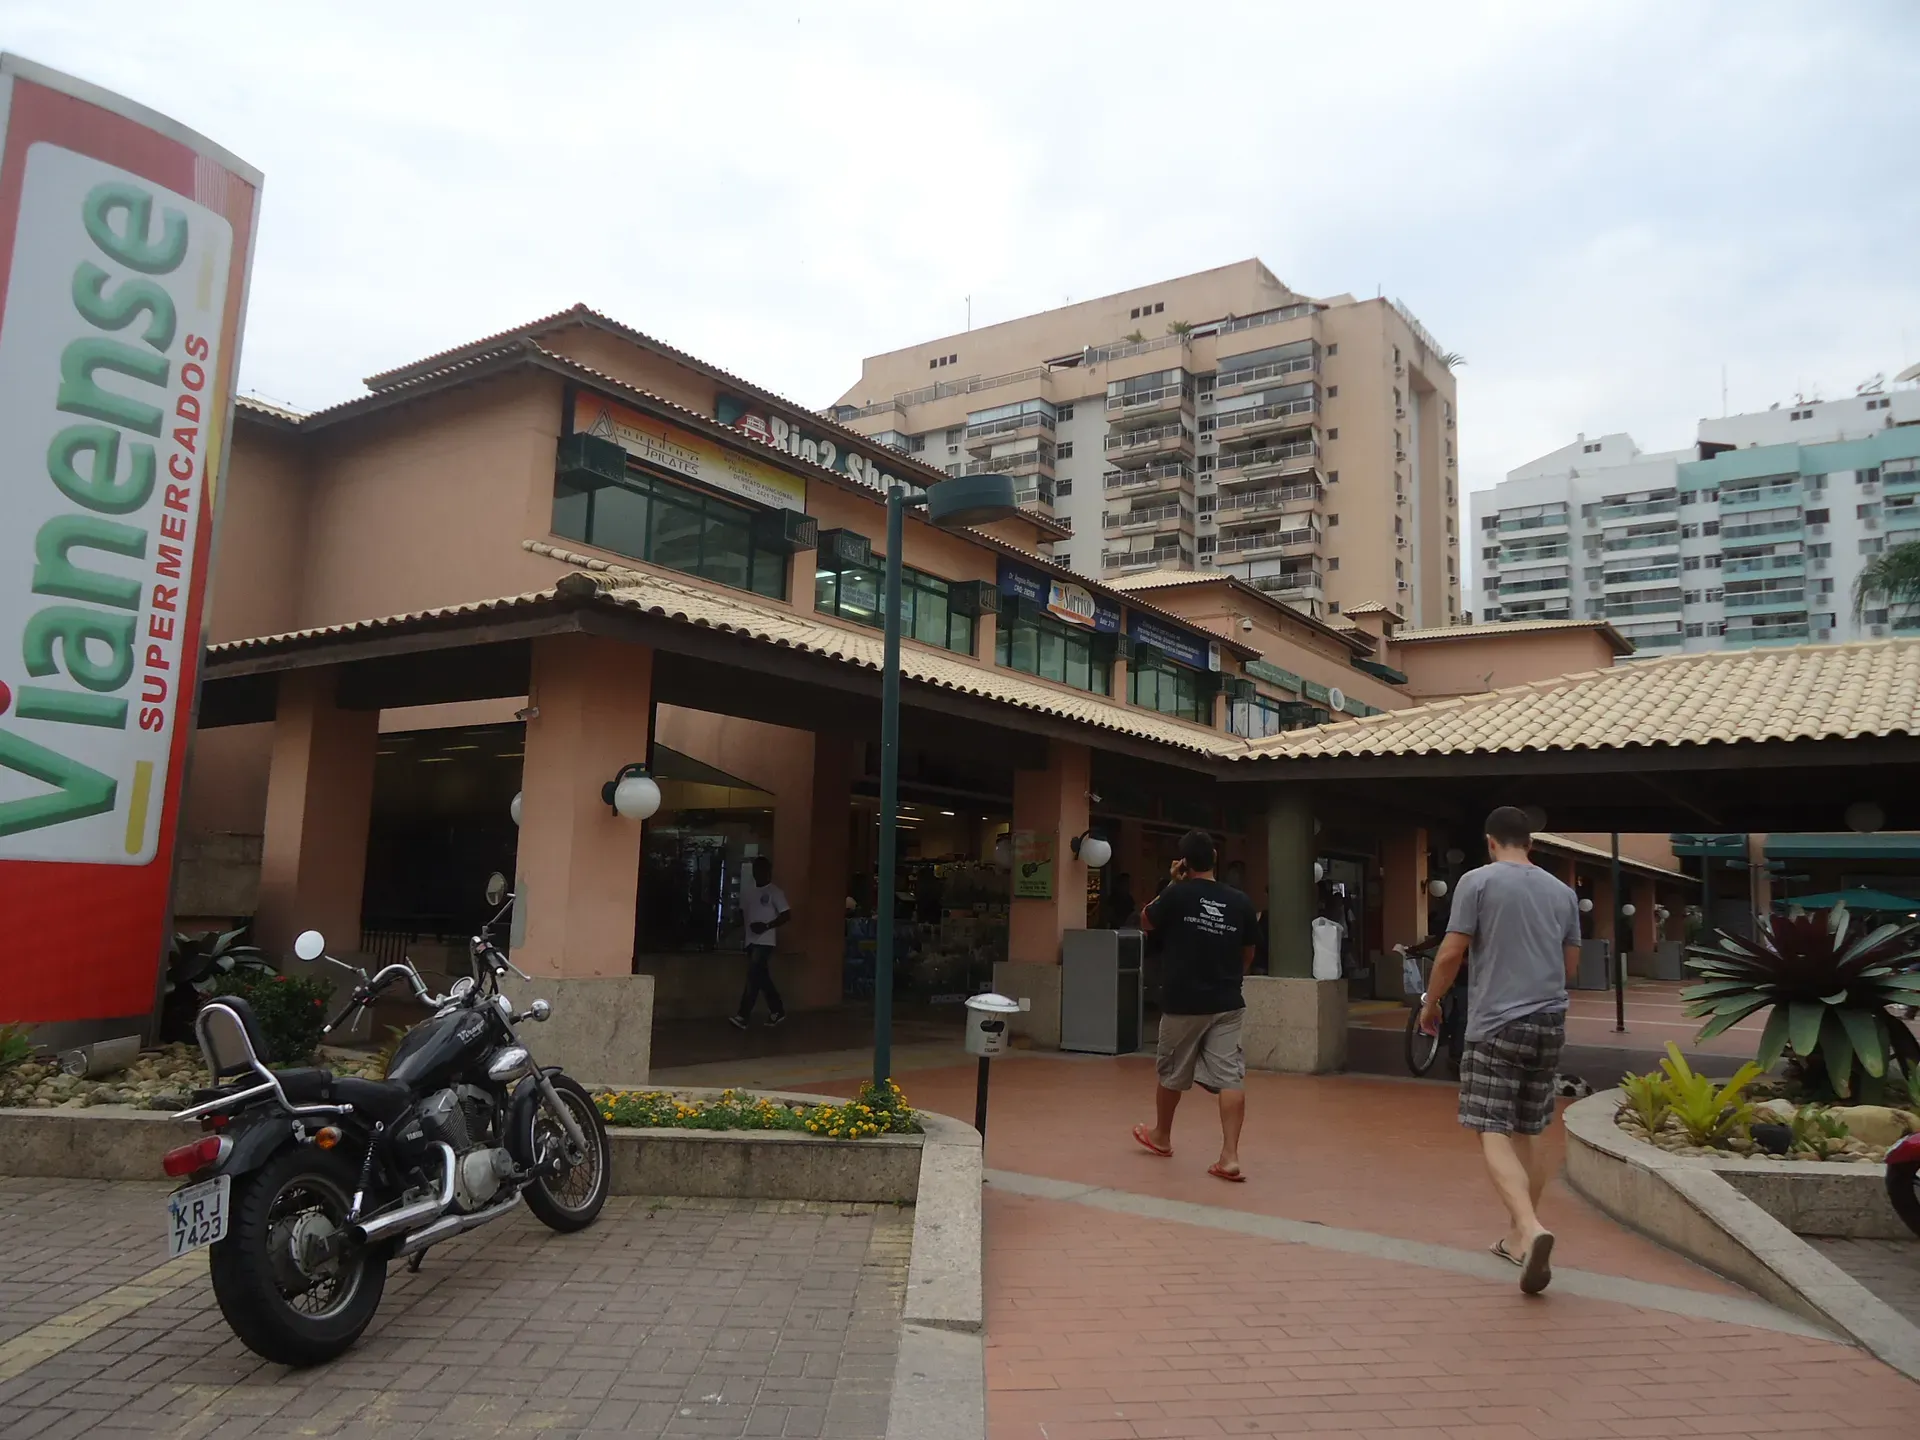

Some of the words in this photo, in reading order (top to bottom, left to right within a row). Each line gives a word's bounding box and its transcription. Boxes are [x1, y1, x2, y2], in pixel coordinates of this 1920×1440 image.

[650, 450, 699, 475] PILATES
[0, 180, 188, 837] Vianense
[139, 333, 209, 733] SUPERMERCADOS
[1064, 585, 1092, 618] Sorriso
[176, 1193, 221, 1230] KRJ
[175, 1216, 221, 1253] 7423
